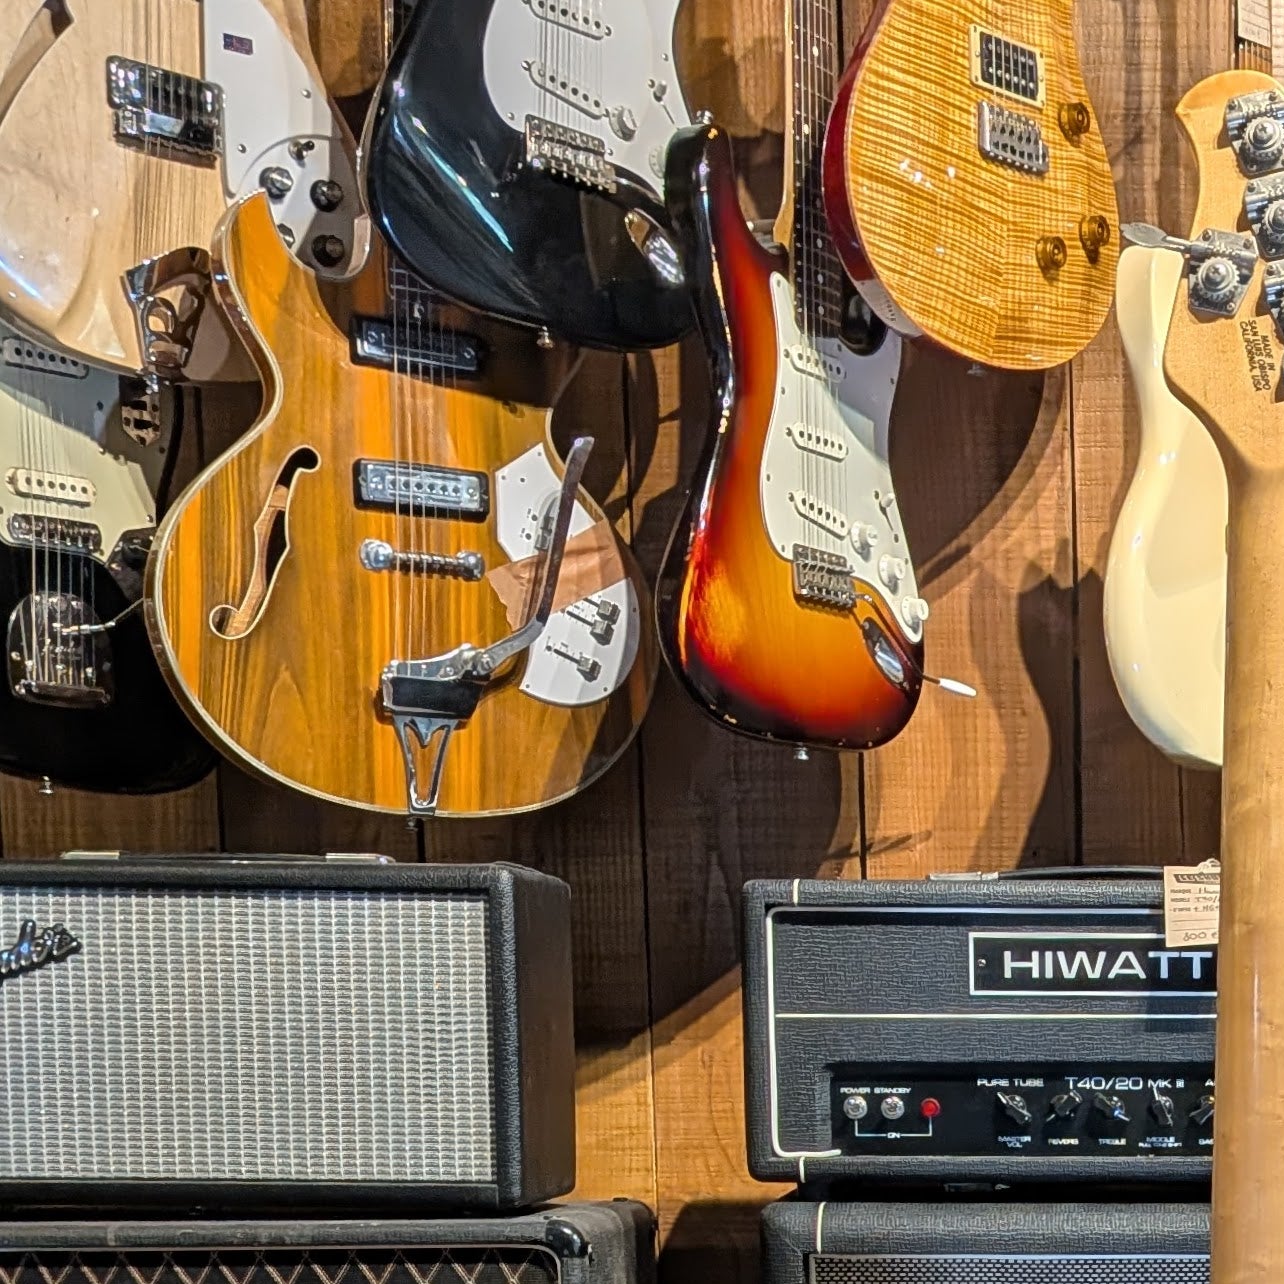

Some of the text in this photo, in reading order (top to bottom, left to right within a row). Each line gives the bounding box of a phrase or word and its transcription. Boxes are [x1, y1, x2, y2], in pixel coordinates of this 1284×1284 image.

[1247, 319, 1272, 391] SAN LUIS OBISPO
[1260, 334, 1276, 371] MADE IN
[1251, 374, 1263, 392] USA
[1003, 950, 1213, 979] HIWATT
[839, 1086, 871, 1094] POWER
[976, 1077, 1045, 1088] PURE TUBE
[1064, 1076, 1143, 1091] T40/20
[1147, 1078, 1172, 1089] MK
[887, 1131, 901, 1139] ON
